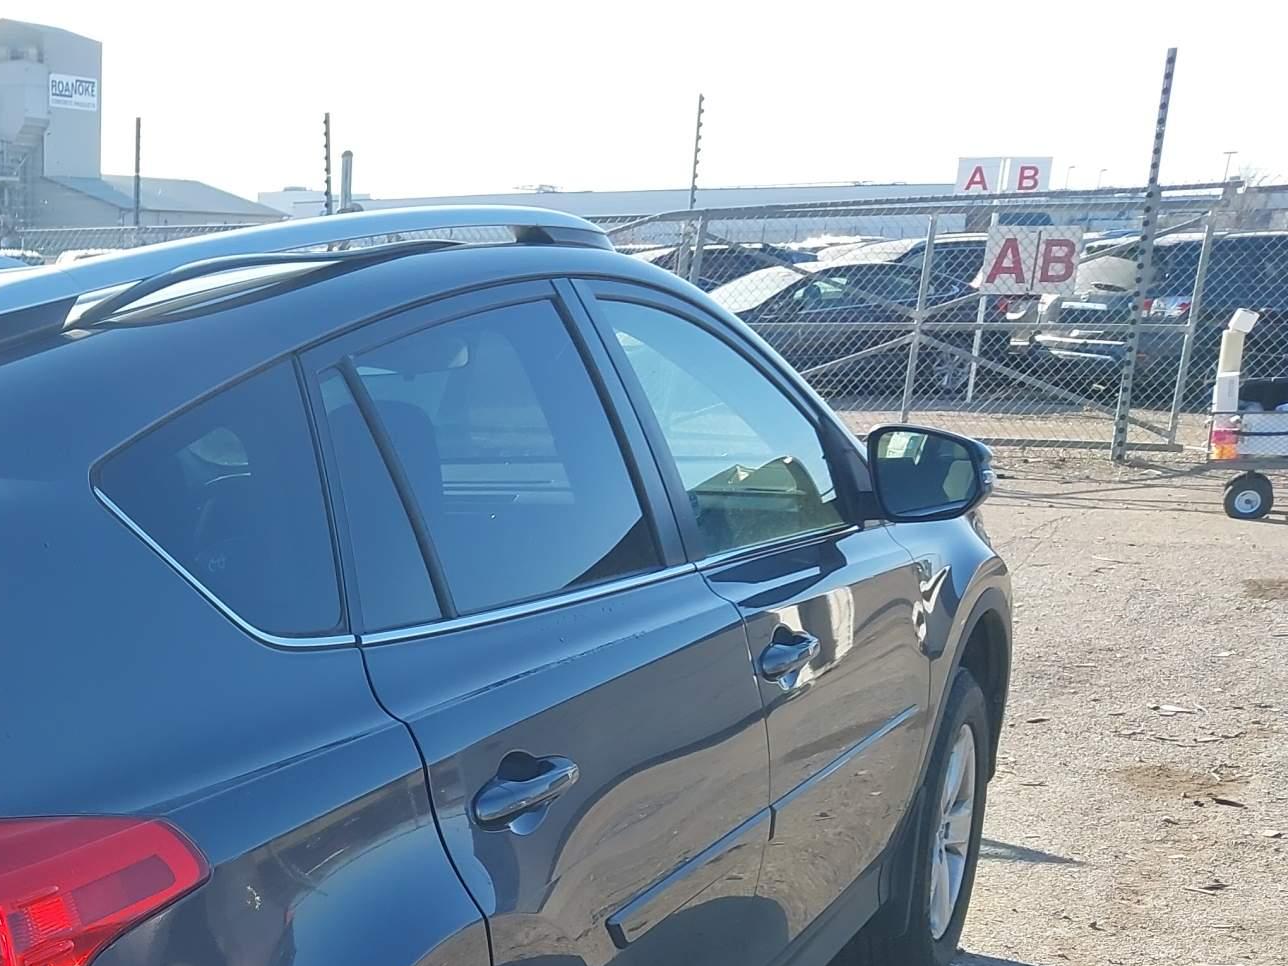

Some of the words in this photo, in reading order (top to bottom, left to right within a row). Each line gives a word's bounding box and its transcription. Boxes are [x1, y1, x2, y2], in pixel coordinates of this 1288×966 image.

[51, 79, 95, 97] ROANOKE
[964, 165, 989, 191] A
[1017, 165, 1040, 191] B
[985, 238, 1026, 285] A
[1038, 238, 1077, 284] B
